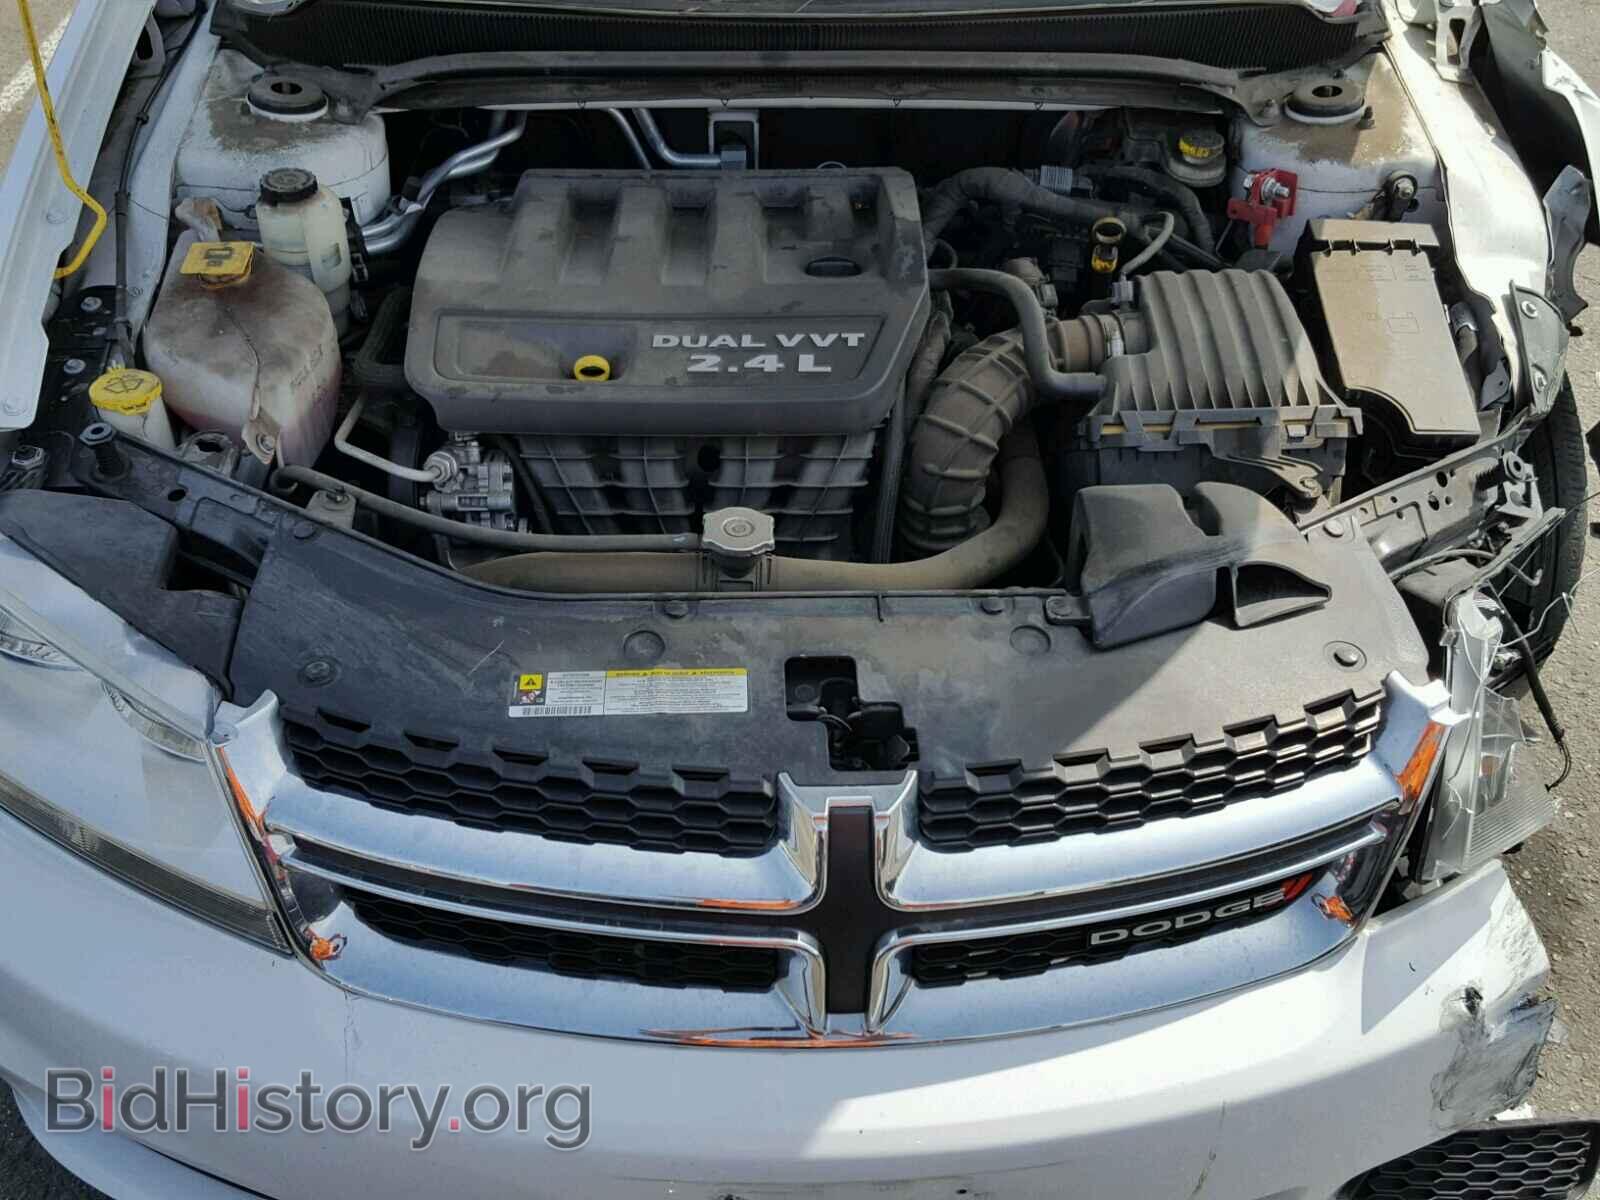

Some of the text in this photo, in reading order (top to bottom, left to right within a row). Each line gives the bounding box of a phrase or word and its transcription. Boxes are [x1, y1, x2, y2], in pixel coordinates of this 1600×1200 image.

[652, 332, 865, 348] DUAL VVT
[1090, 887, 1286, 945] DODGE
